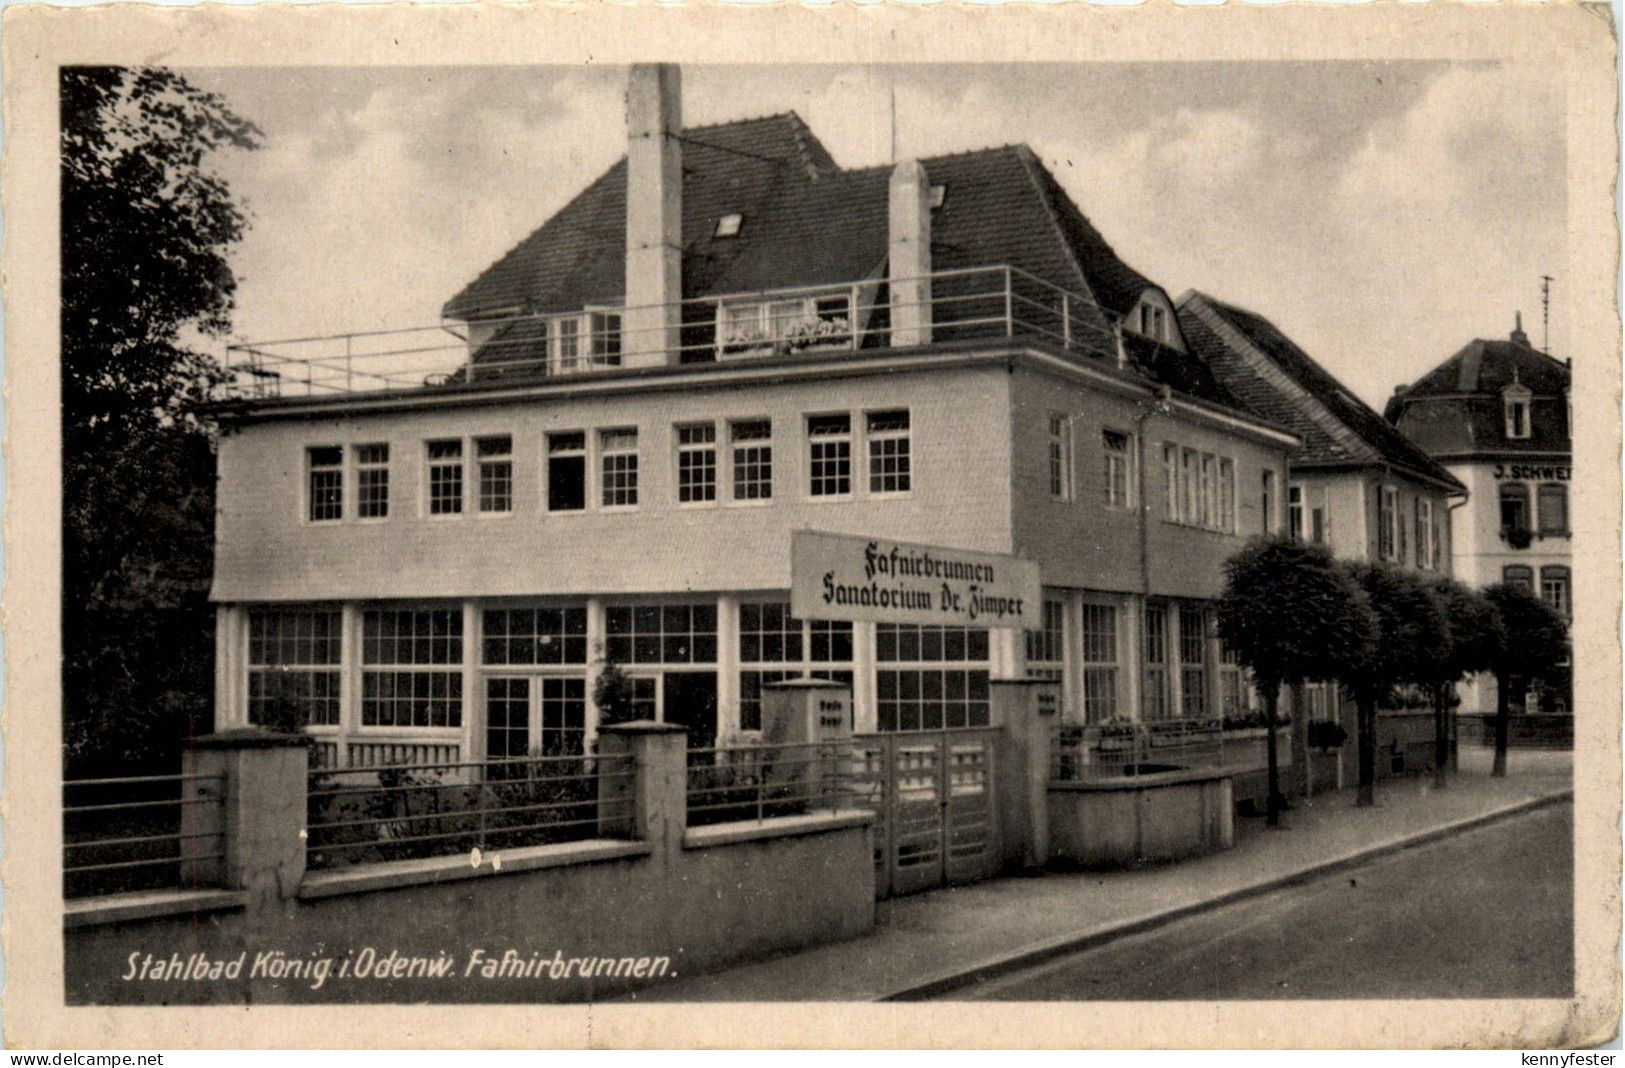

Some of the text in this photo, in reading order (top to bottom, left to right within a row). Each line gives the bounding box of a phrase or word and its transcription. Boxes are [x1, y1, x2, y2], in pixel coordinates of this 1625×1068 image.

[864, 542, 994, 583] Fafnirbrunnen
[823, 571, 1024, 620] Sanatorium Dr. Zimper
